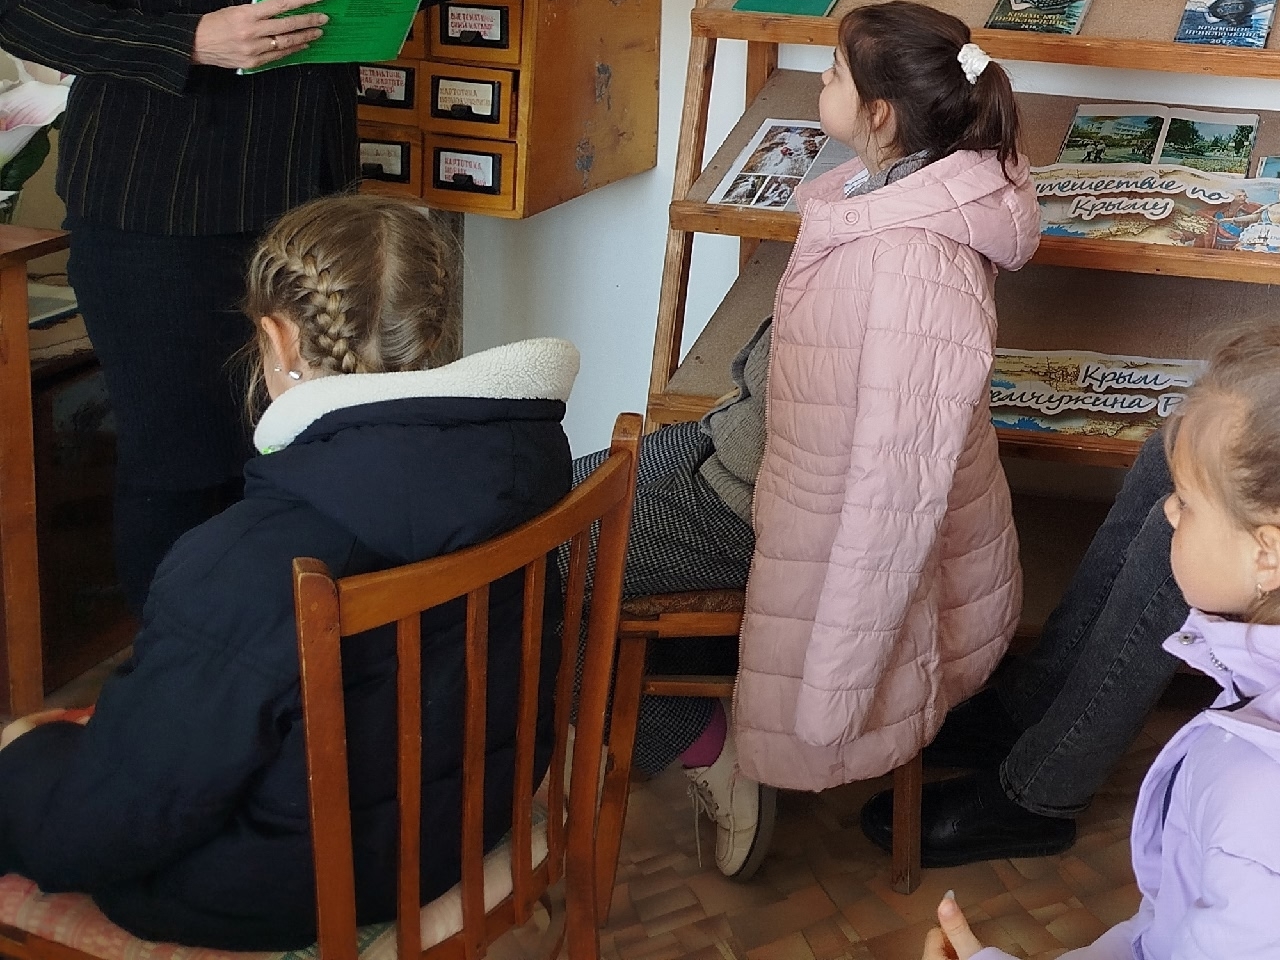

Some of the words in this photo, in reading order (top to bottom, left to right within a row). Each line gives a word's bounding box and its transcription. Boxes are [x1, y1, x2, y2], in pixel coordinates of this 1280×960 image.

[1190, 184, 1230, 201] по
[1071, 198, 1171, 217] Крыму
[1081, 364, 1170, 388] Крым
